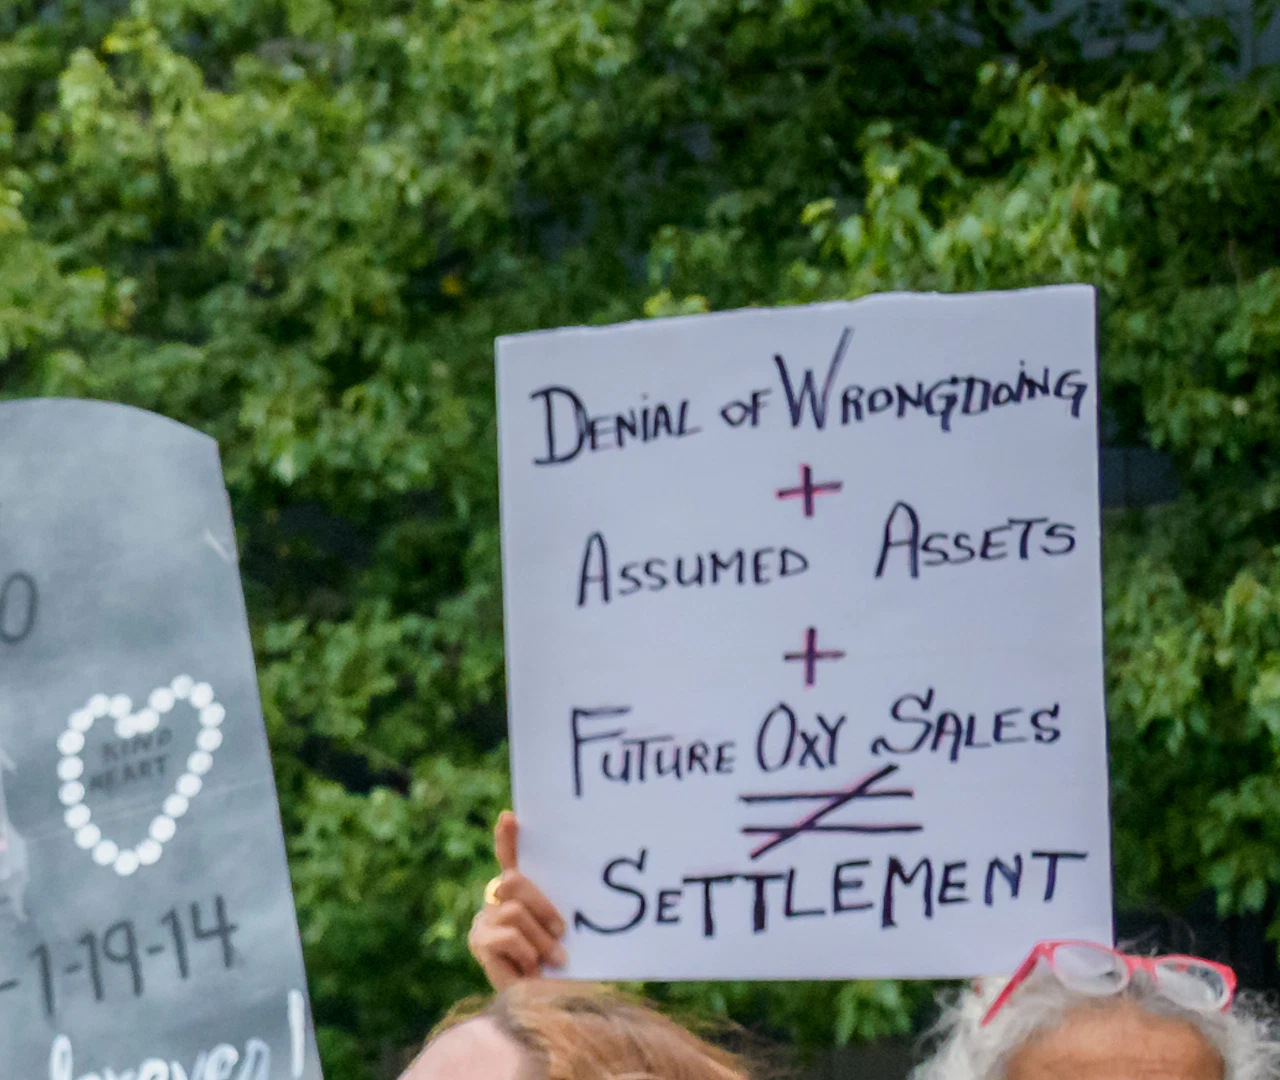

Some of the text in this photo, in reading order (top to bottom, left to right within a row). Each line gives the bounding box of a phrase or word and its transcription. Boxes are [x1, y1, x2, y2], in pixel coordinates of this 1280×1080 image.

[577, 501, 1078, 608] ASSUMED ASSETS
[571, 706, 736, 798] FUTURE
[872, 688, 1062, 762] SALES
[574, 848, 1089, 938] SETTLEMENT
